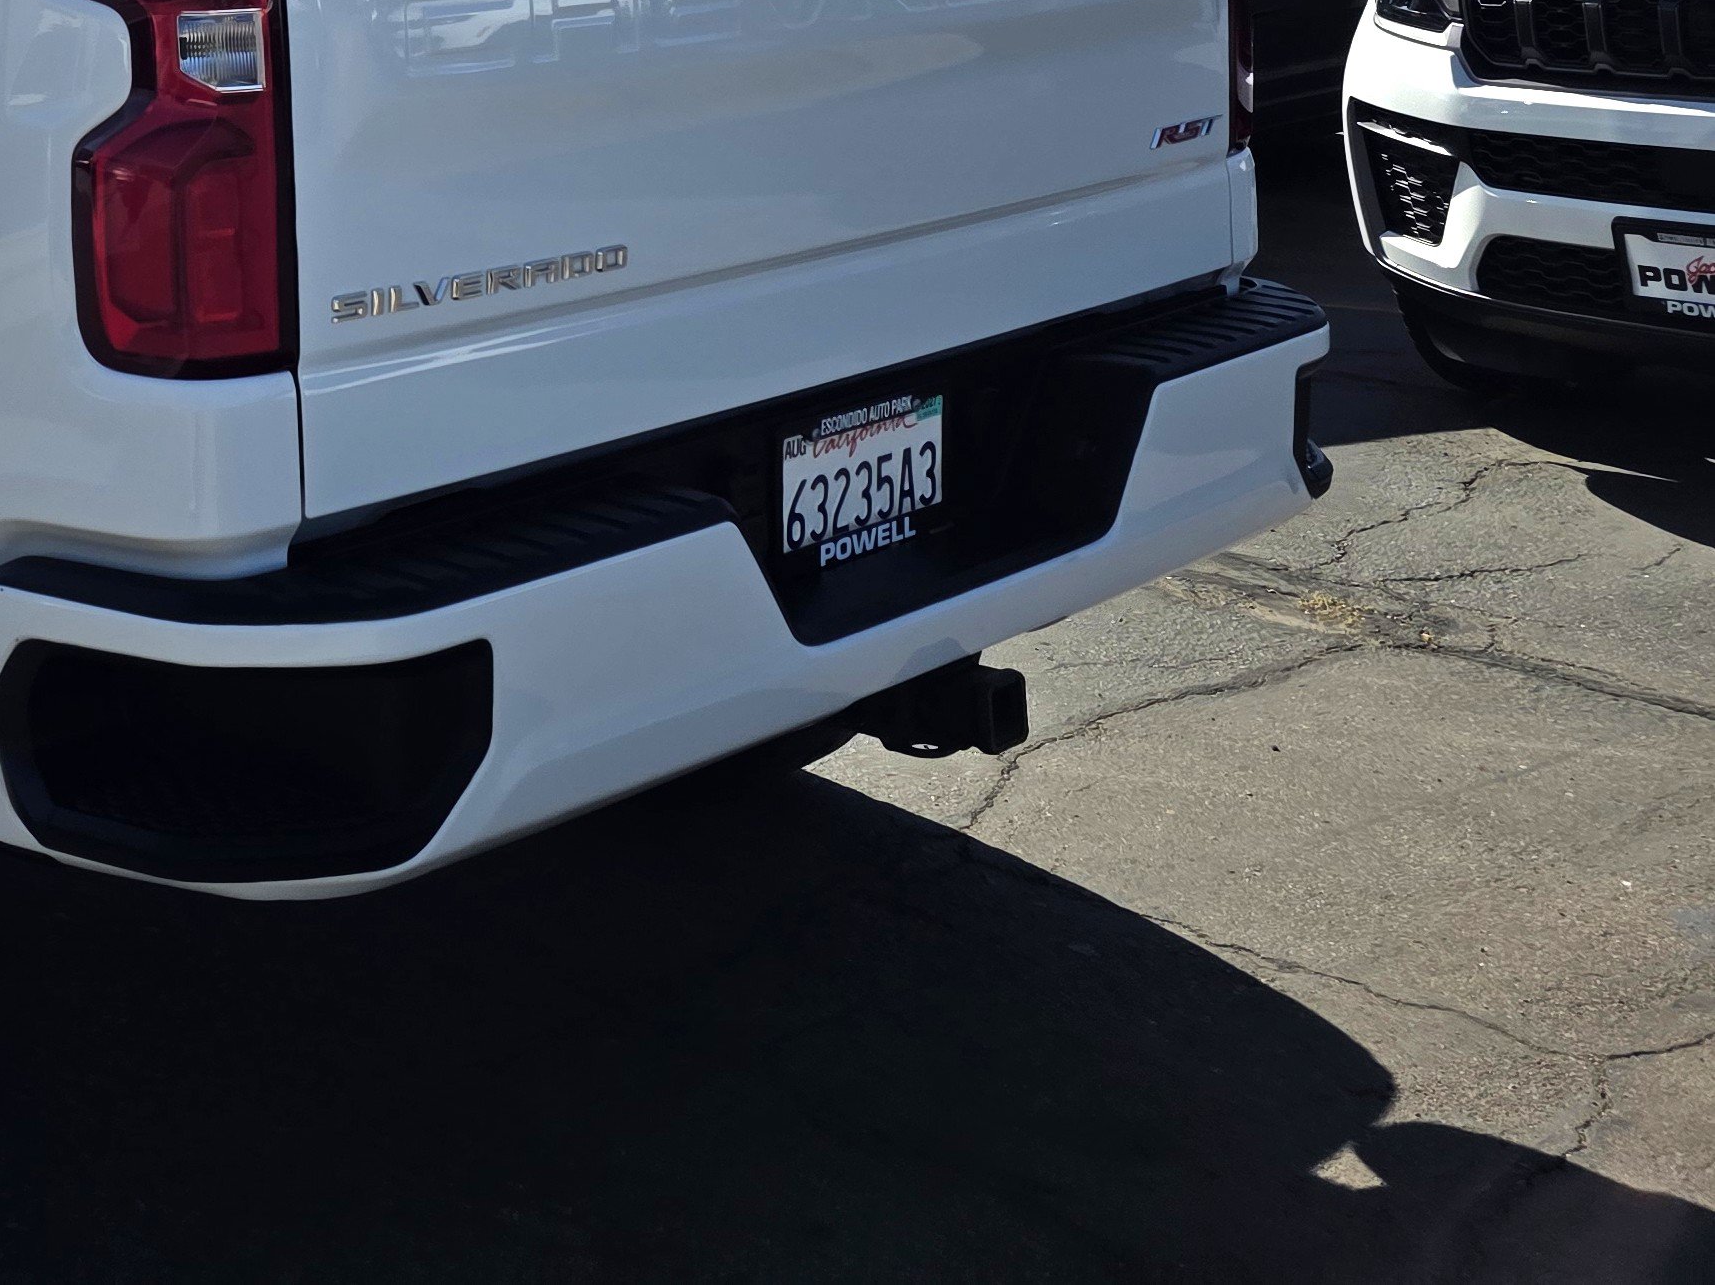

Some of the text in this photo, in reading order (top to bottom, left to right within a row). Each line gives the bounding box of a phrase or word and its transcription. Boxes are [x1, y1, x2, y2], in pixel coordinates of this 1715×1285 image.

[1149, 114, 1224, 149] RST
[331, 244, 628, 324] SILVERADO
[820, 408, 868, 435] ESCONDIDO
[869, 400, 891, 423] AUTO
[891, 394, 913, 415] PARK
[784, 436, 807, 461] AUG
[785, 440, 937, 551] 63235A3
[819, 516, 917, 567] POWELL
